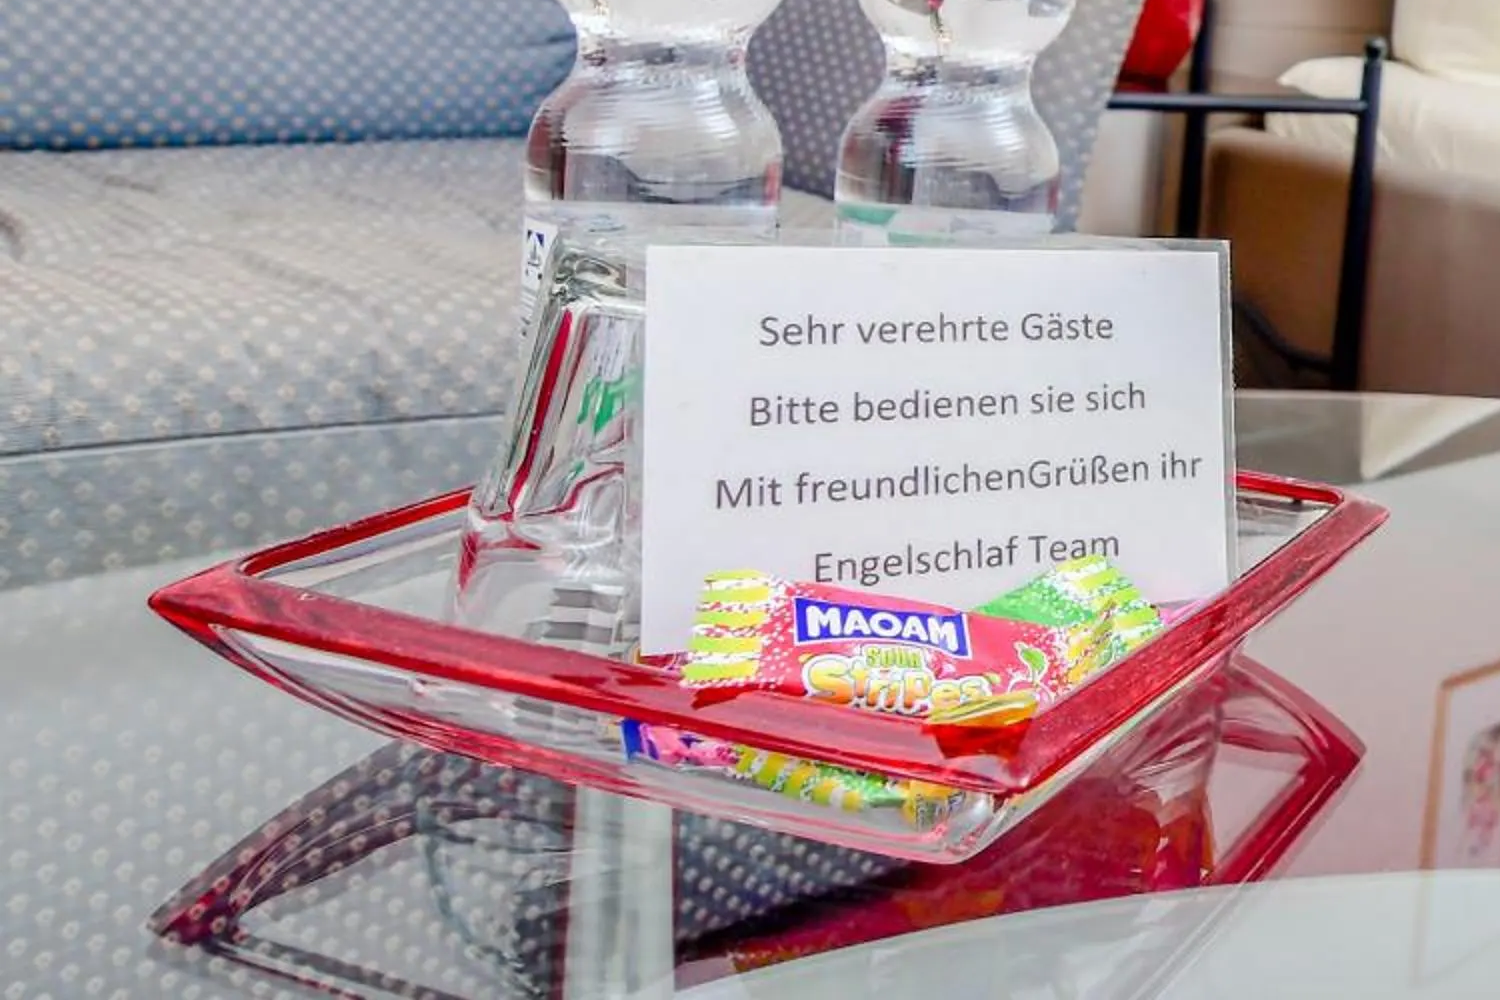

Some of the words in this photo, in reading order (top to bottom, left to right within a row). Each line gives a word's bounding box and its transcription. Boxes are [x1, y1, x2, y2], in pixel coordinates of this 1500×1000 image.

[759, 314, 845, 347] Sehr
[856, 312, 1009, 344] verehrte
[1021, 311, 1114, 341] Gäste
[750, 395, 839, 427] Bitte
[854, 389, 1018, 422] bedienen
[1030, 385, 1075, 414] sie
[1086, 381, 1146, 412] sich
[716, 475, 782, 510] Mit
[1161, 451, 1202, 480] ihr
[815, 535, 1019, 586] Engelschlaf
[1027, 534, 1120, 564] Team
[805, 605, 959, 652] MAOAM
